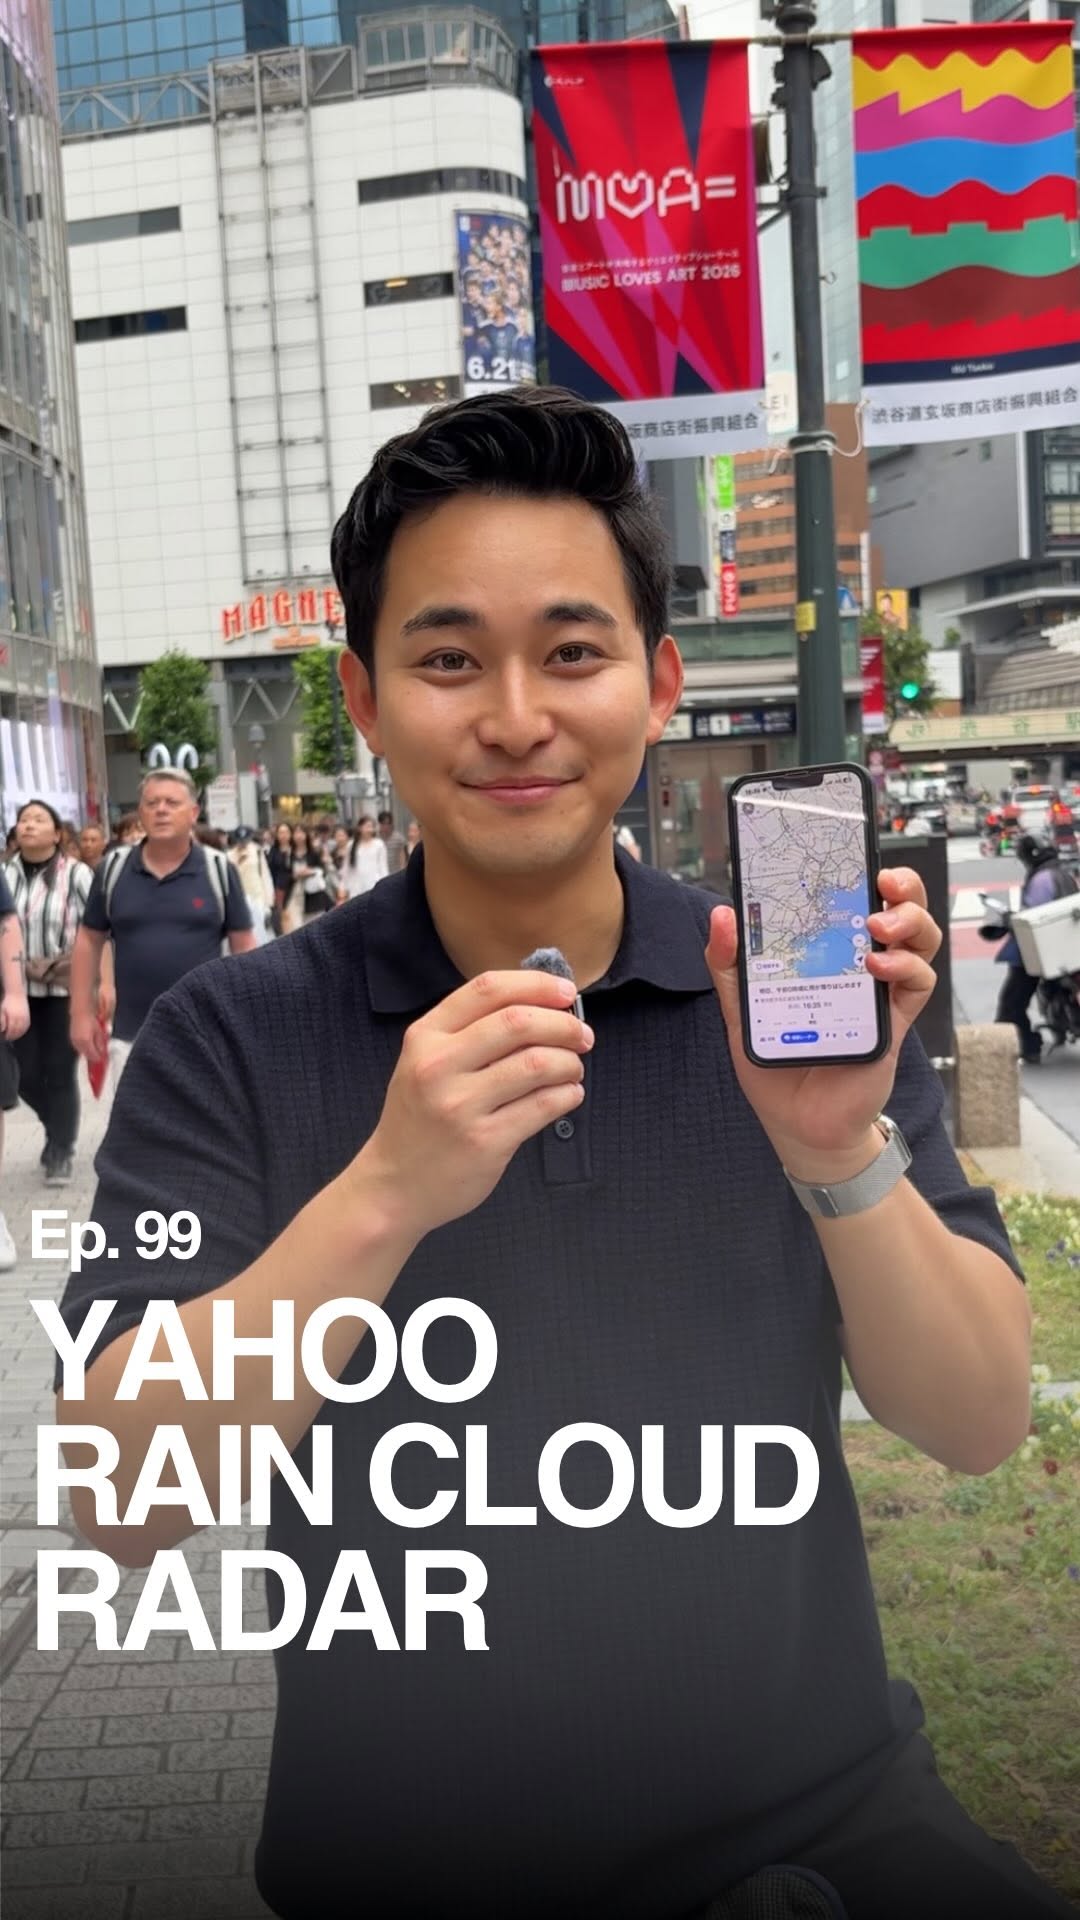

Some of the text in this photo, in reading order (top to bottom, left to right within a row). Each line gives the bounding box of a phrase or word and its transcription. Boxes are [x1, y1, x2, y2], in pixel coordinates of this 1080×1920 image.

[561, 275, 610, 293] MUSIC
[614, 271, 662, 287] LOVES
[666, 266, 698, 282] ART
